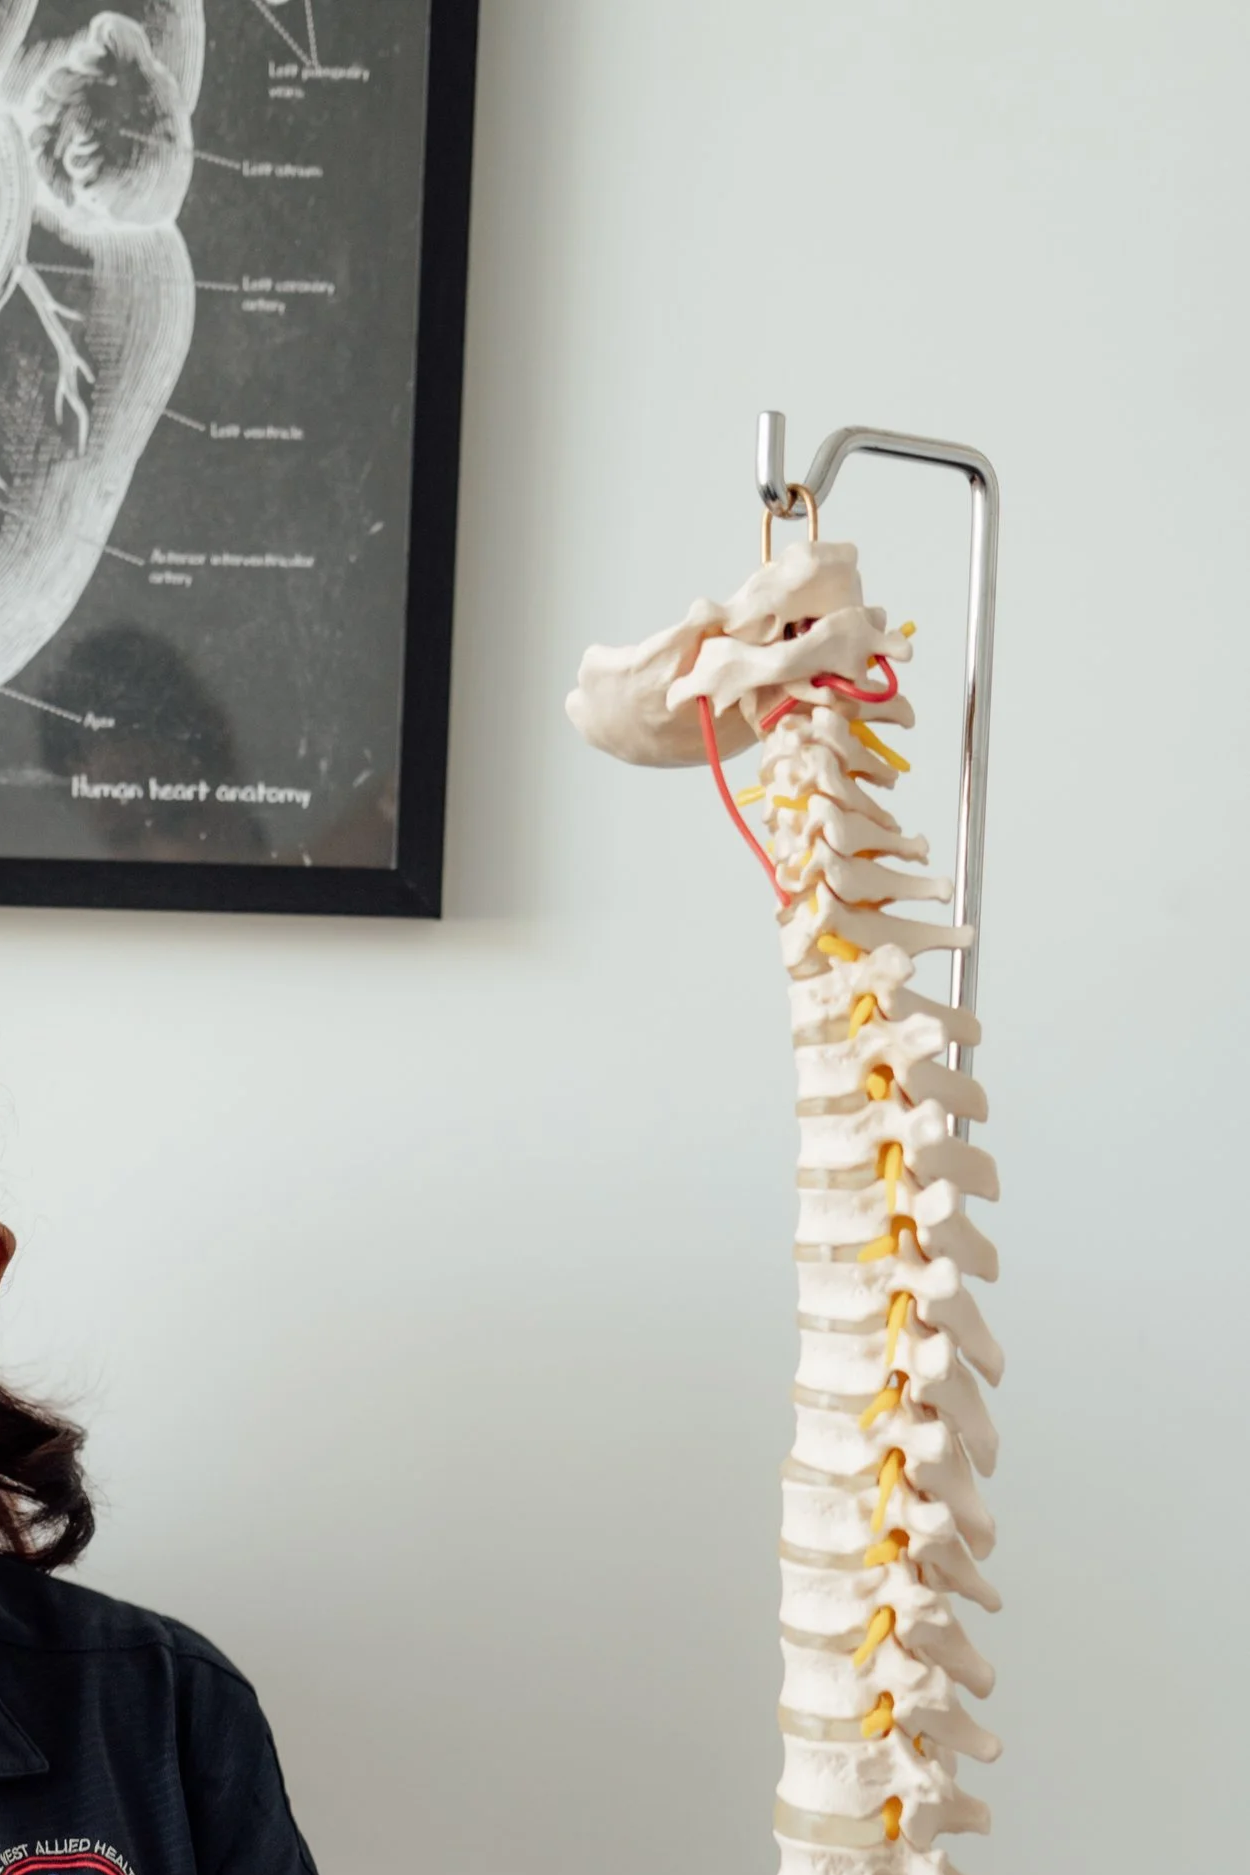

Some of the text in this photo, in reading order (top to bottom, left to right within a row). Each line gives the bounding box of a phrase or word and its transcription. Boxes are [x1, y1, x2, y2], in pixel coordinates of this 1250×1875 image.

[71, 773, 312, 810] Human heart anatomy
[35, 1837, 91, 1856] ALLIED
